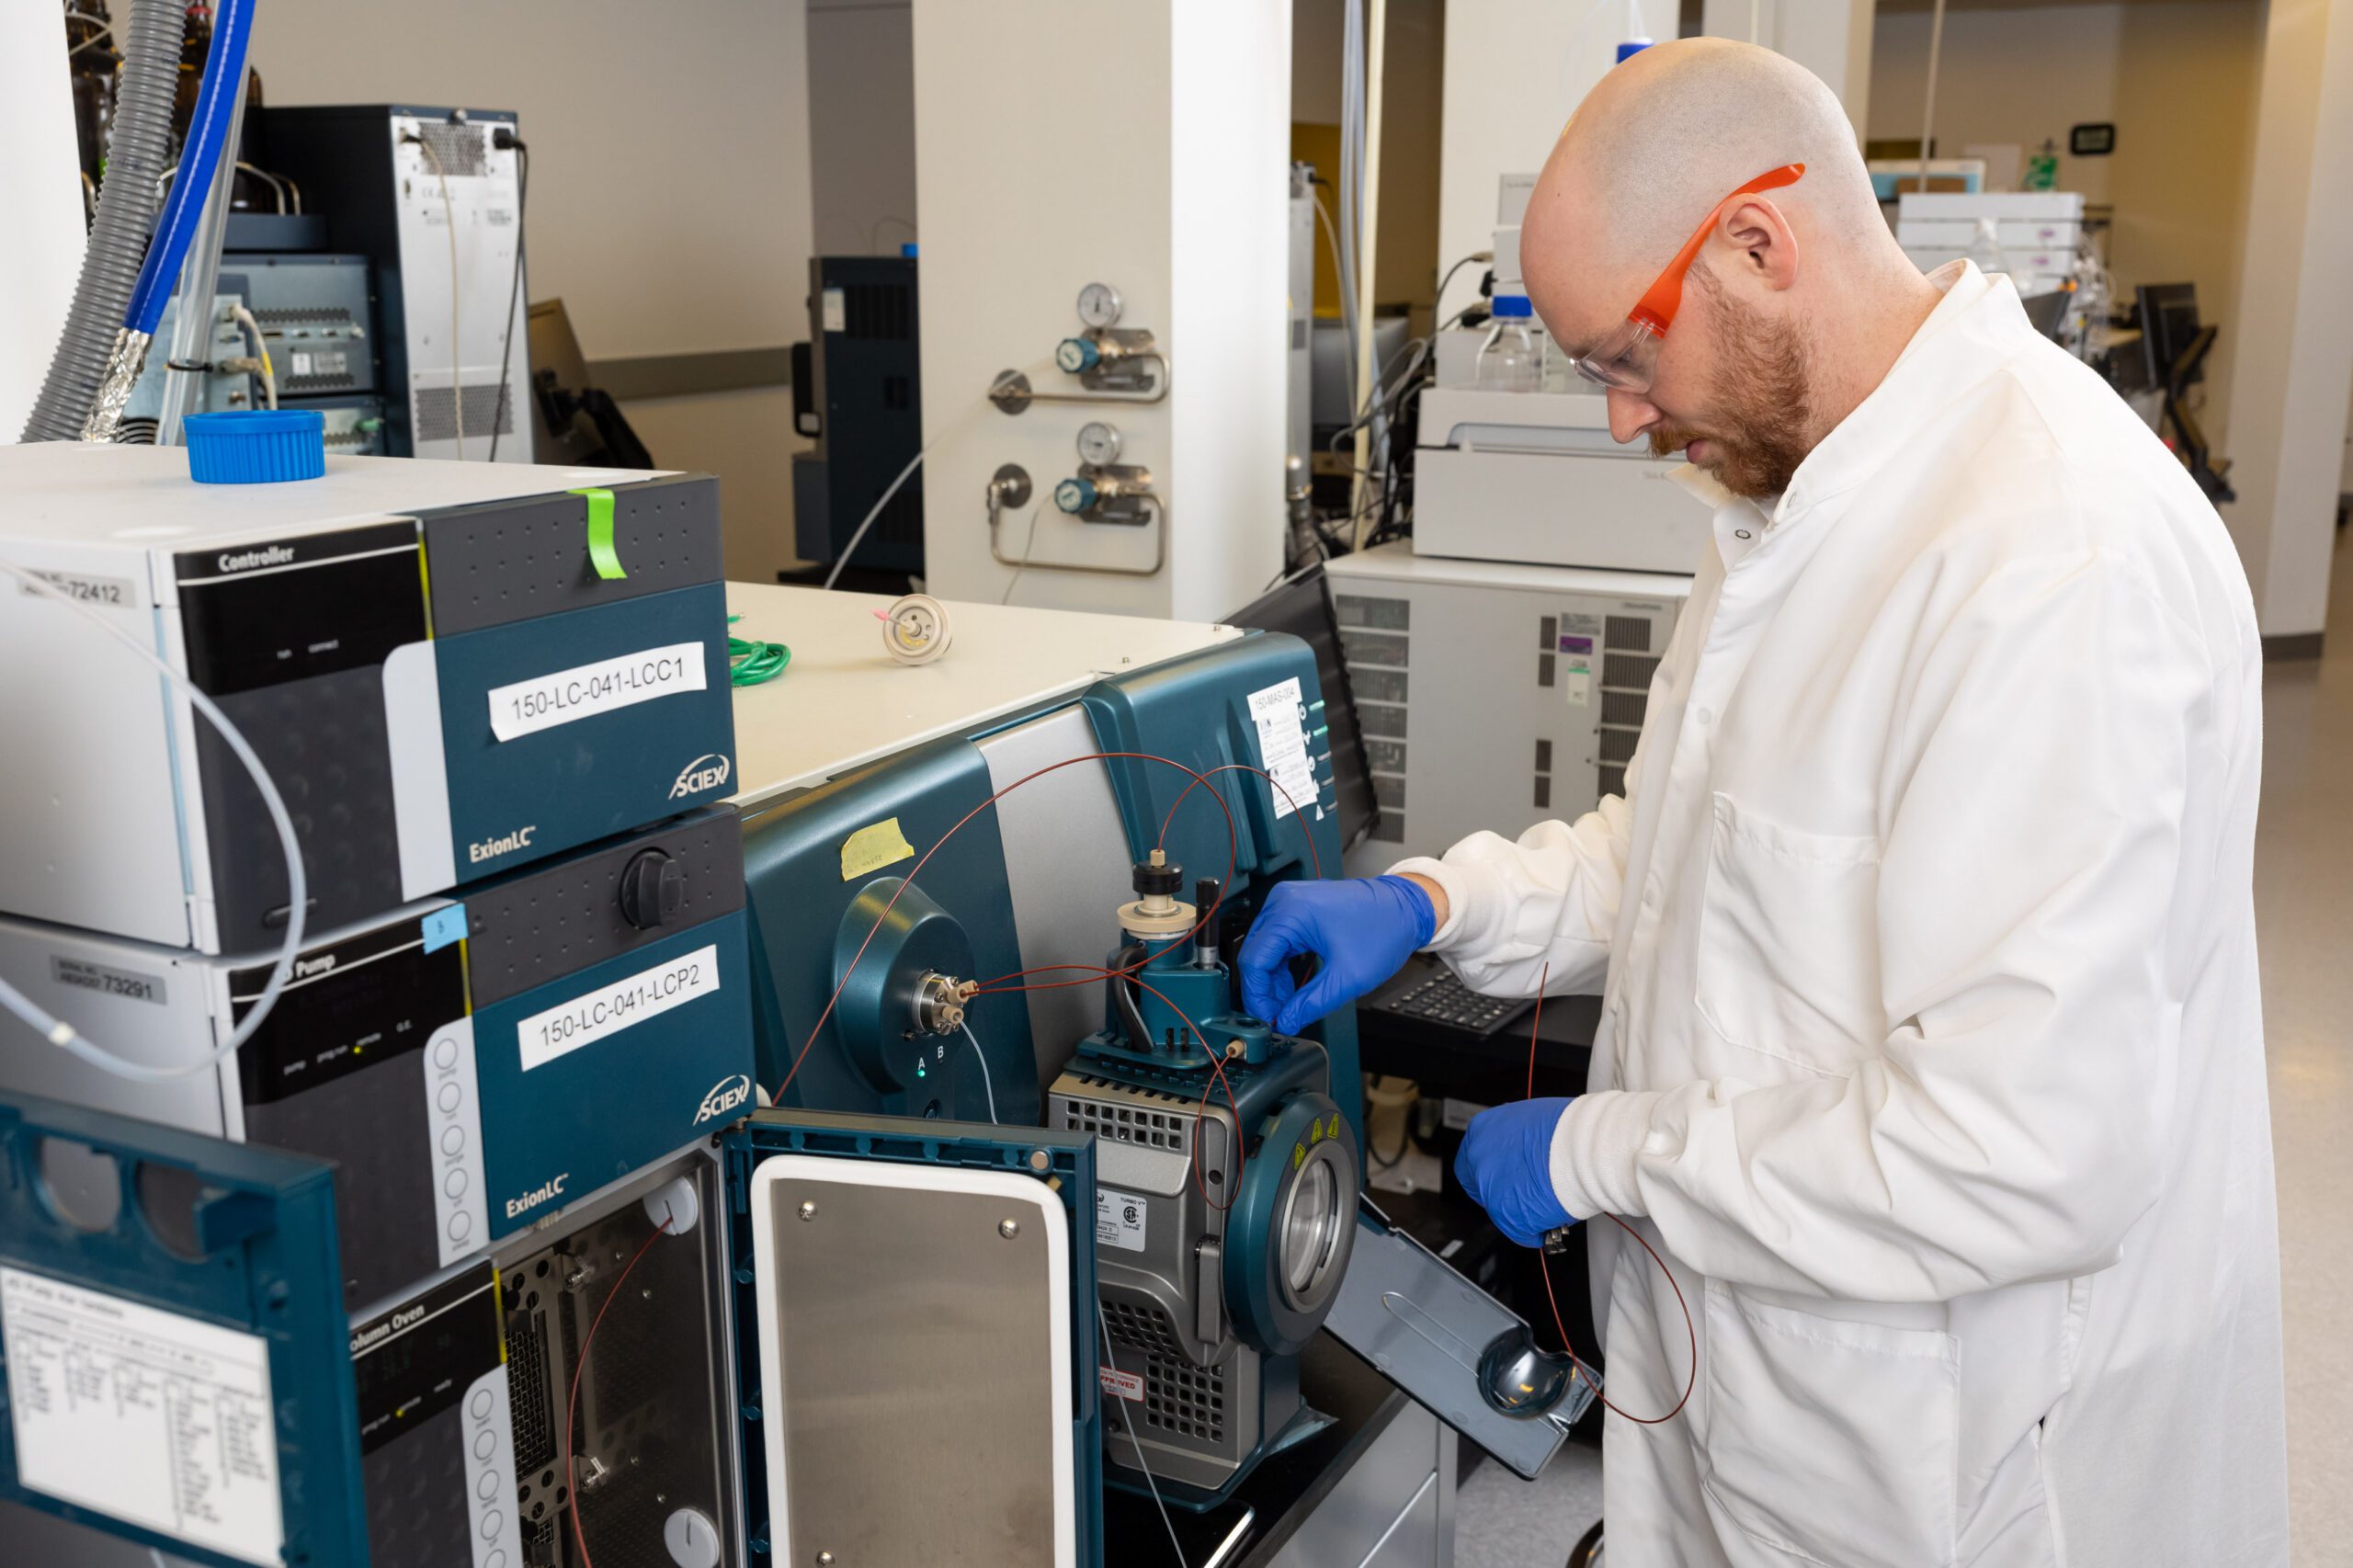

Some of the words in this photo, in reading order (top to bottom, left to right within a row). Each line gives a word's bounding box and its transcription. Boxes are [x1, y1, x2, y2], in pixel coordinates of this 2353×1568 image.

[218, 546, 294, 572] Controller
[69, 581, 120, 603] 72412
[511, 657, 684, 720] 150-LC-041-LCC1
[672, 763, 727, 799] SCIEX
[296, 954, 336, 978] Pump
[102, 974, 153, 999] 73291
[540, 964, 700, 1046] 150-LC-041-LCP2
[917, 1056, 926, 1071] A
[938, 1045, 944, 1059] B
[697, 1083, 747, 1124] SCIEX
[350, 1324, 391, 1352] olumn
[392, 1304, 425, 1330] Oven
